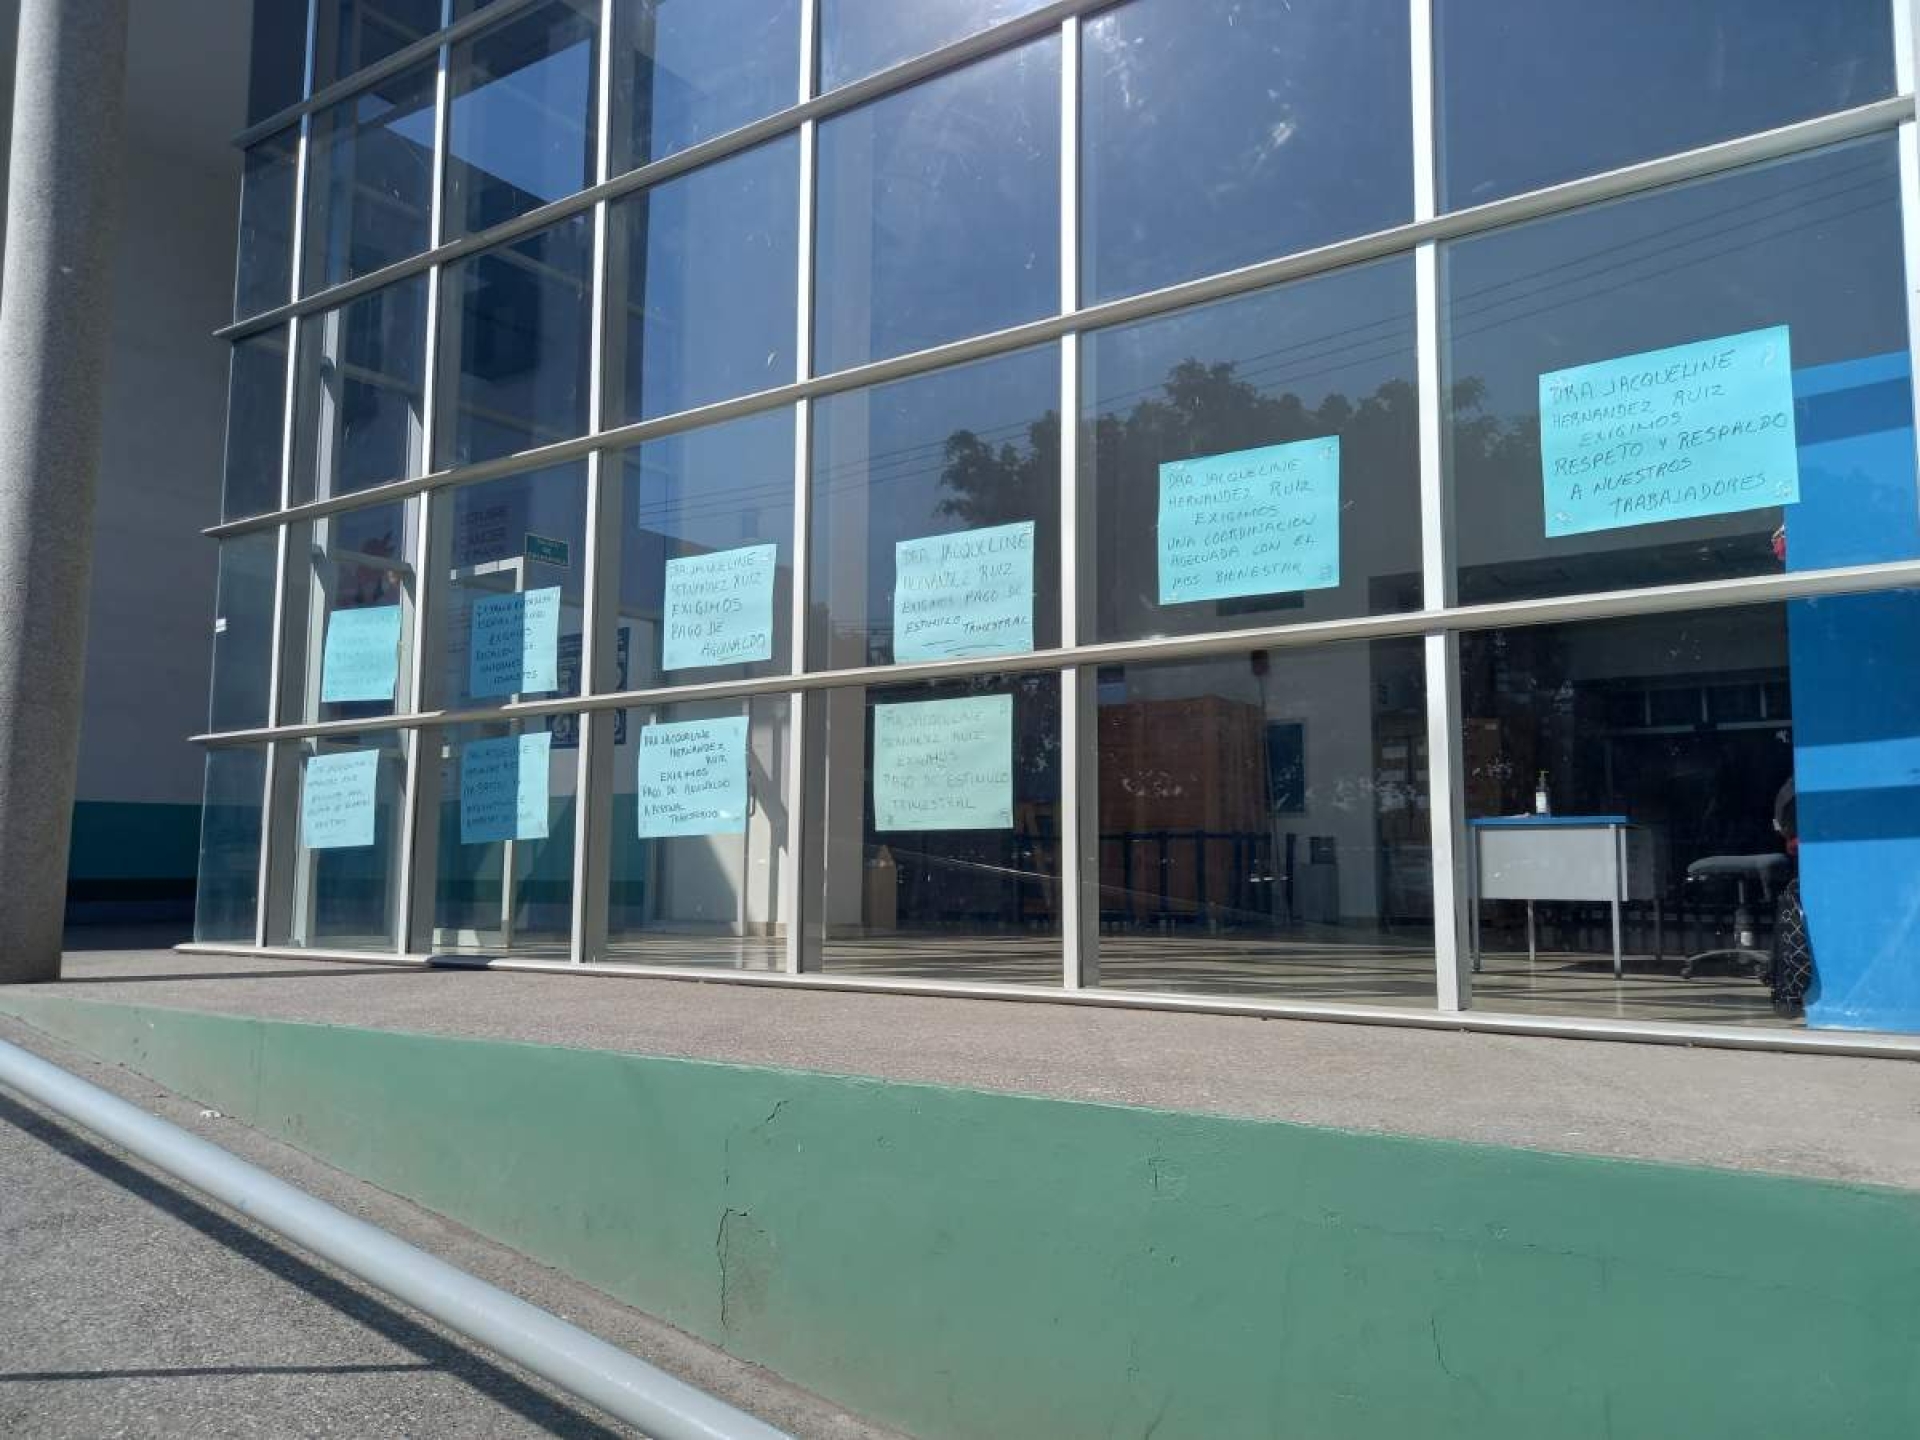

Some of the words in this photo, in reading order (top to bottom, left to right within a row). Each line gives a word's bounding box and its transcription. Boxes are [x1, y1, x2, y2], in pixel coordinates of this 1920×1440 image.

[1601, 349, 1736, 396] JACQUELINE
[1553, 401, 1653, 429] HERNANDEZ
[1673, 384, 1726, 406] RUIZ
[1554, 442, 1643, 476] RESPETO
[1678, 412, 1787, 450] RESPALDO
[1580, 411, 1681, 448] EXIGIMOS
[1168, 488, 1251, 507] HERNANDEZ
[1270, 480, 1314, 496] RUIZ
[1571, 483, 1583, 500] A
[1593, 457, 1692, 494] NUESTROS
[1610, 474, 1766, 516] TRABAJADORES
[1168, 535, 1196, 550] UNA
[1252, 540, 1281, 555] CON
[672, 598, 743, 618] EXIGIMOS
[671, 623, 702, 640] PAGO
[707, 617, 725, 635] DE
